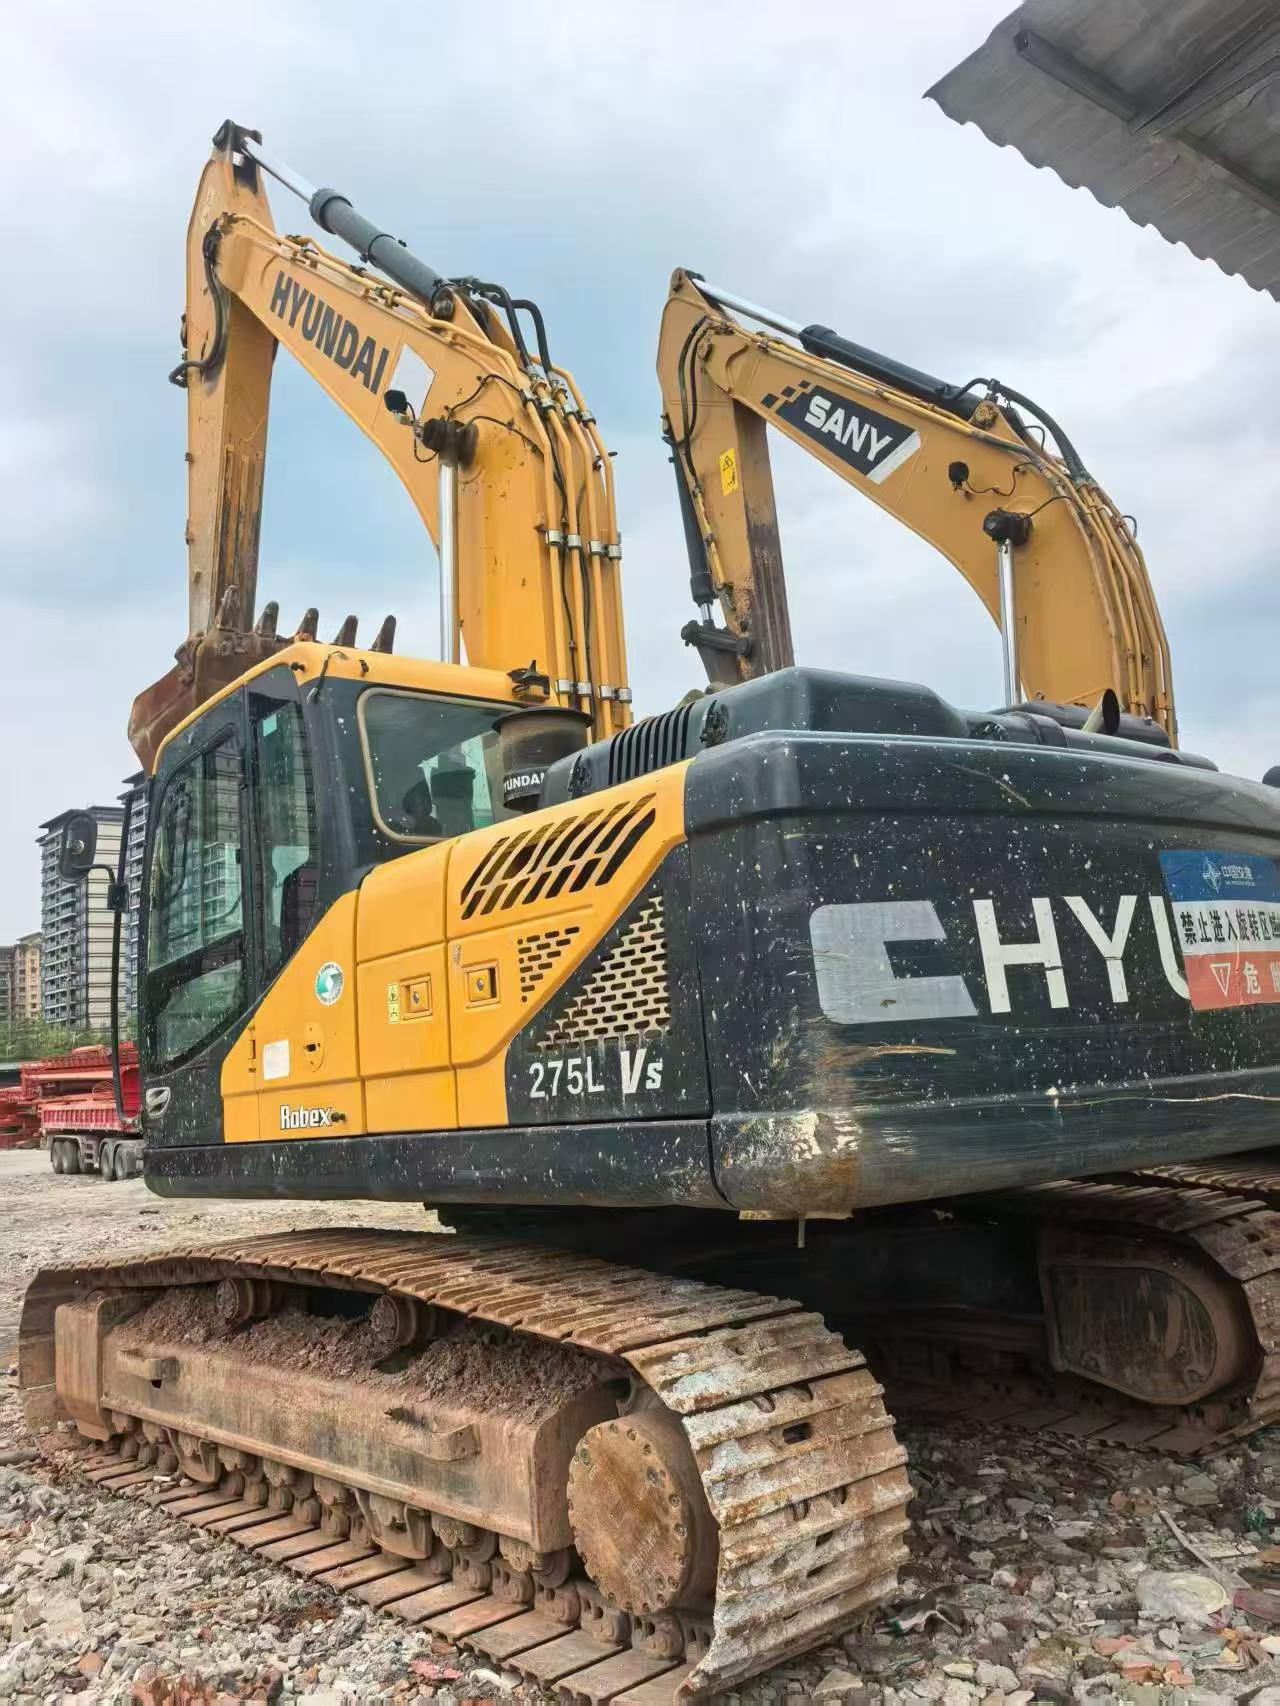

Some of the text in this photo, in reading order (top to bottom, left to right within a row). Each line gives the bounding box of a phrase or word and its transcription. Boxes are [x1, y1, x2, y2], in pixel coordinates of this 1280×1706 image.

[270, 270, 391, 396] HYUNDAI
[804, 394, 894, 462] SANY
[528, 1048, 663, 1098] 275L Vs
[280, 1104, 333, 1130] Robex
